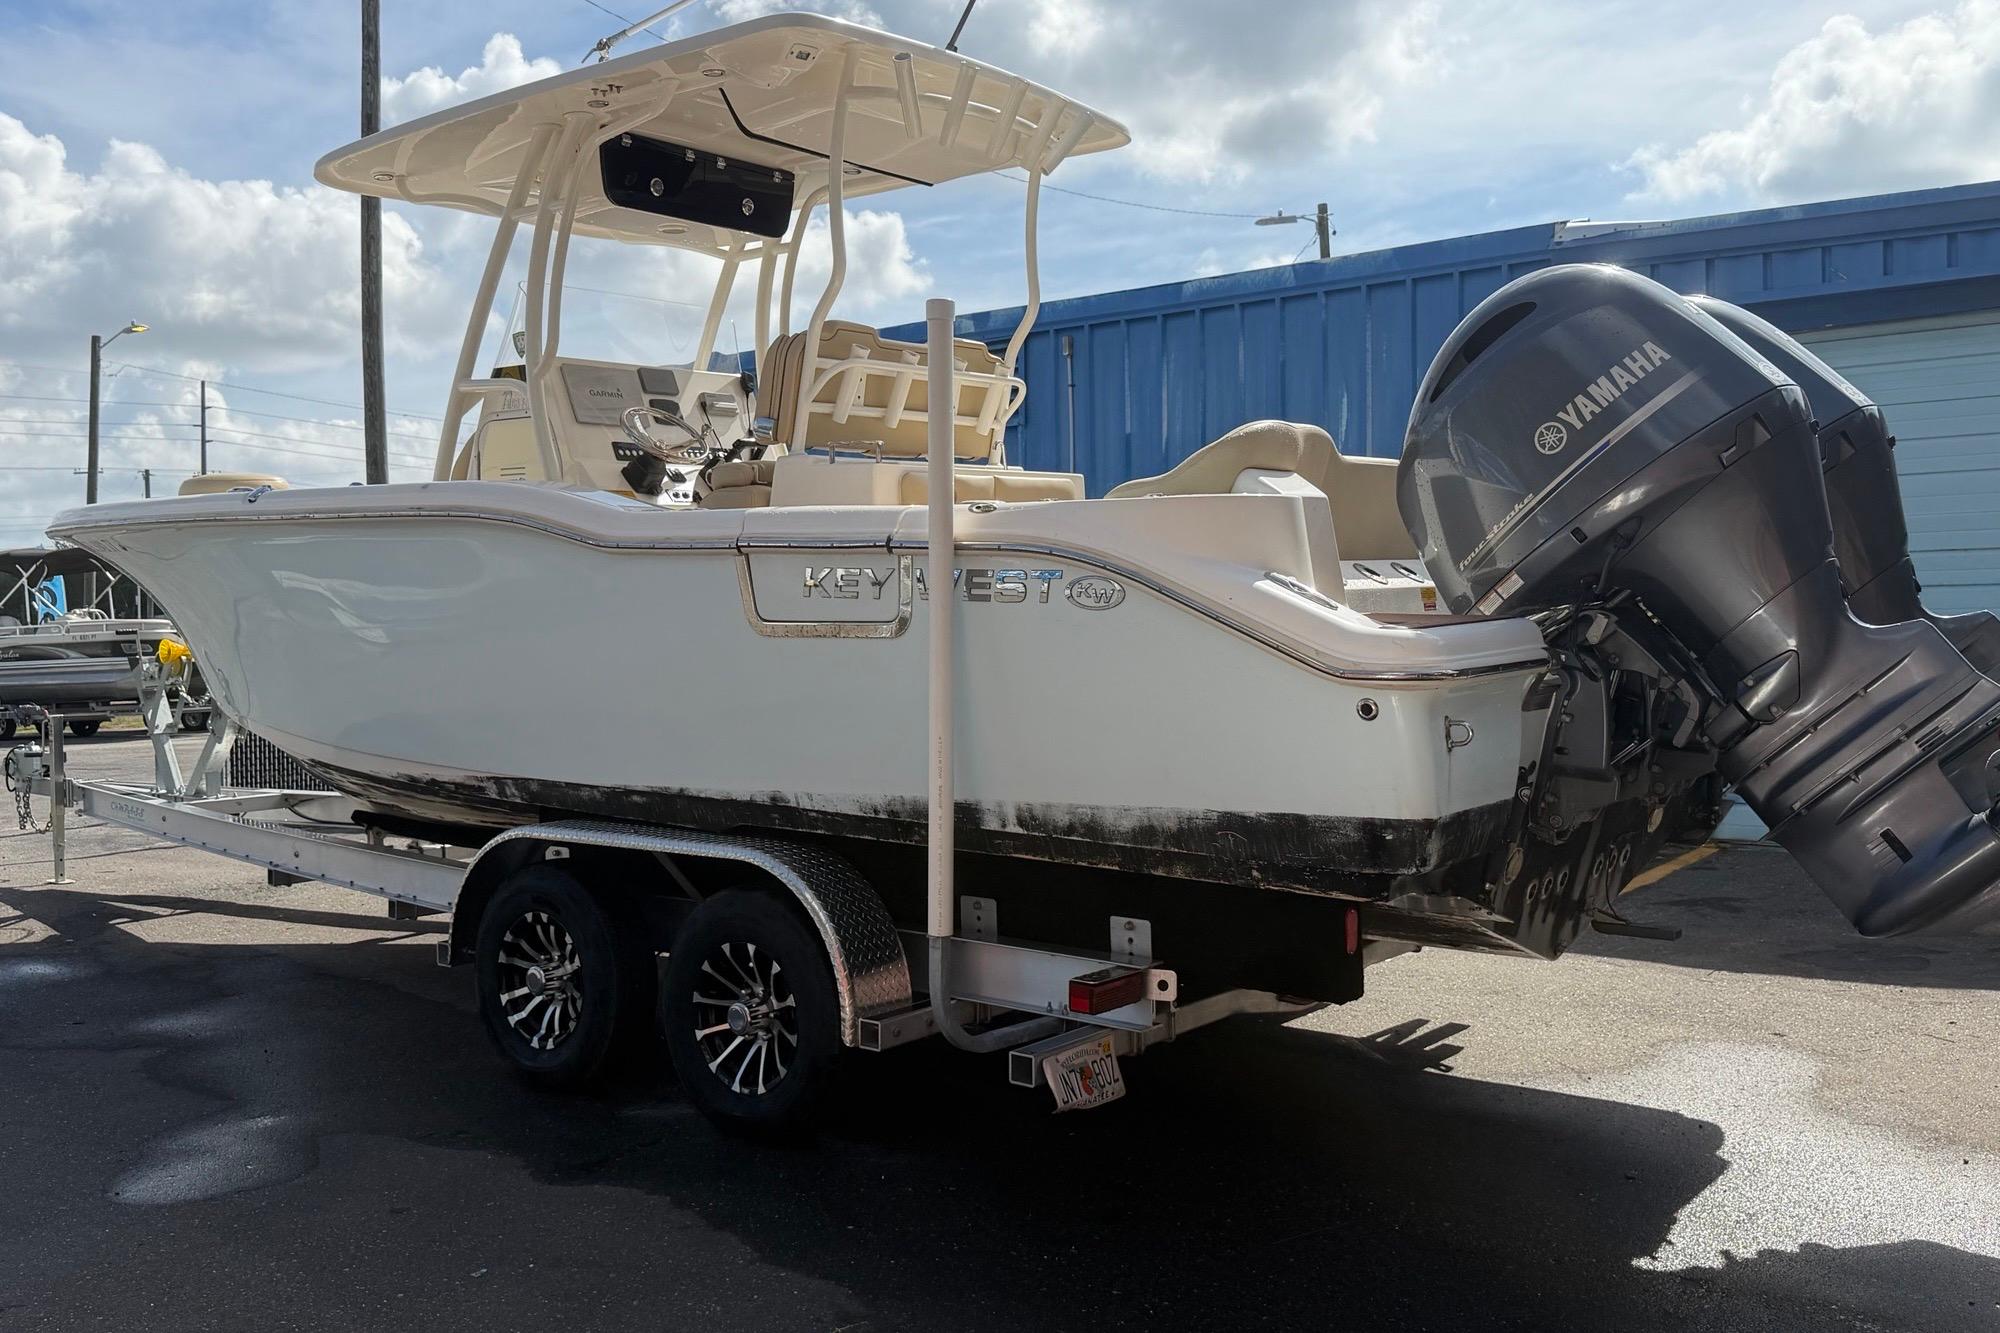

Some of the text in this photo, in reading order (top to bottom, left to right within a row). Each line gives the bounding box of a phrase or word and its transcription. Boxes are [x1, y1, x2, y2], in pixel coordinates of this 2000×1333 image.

[588, 388, 624, 399] GARMIN
[1556, 340, 1672, 430] YAMAHA
[802, 567, 896, 600] KEY
[1077, 581, 1117, 605] KW
